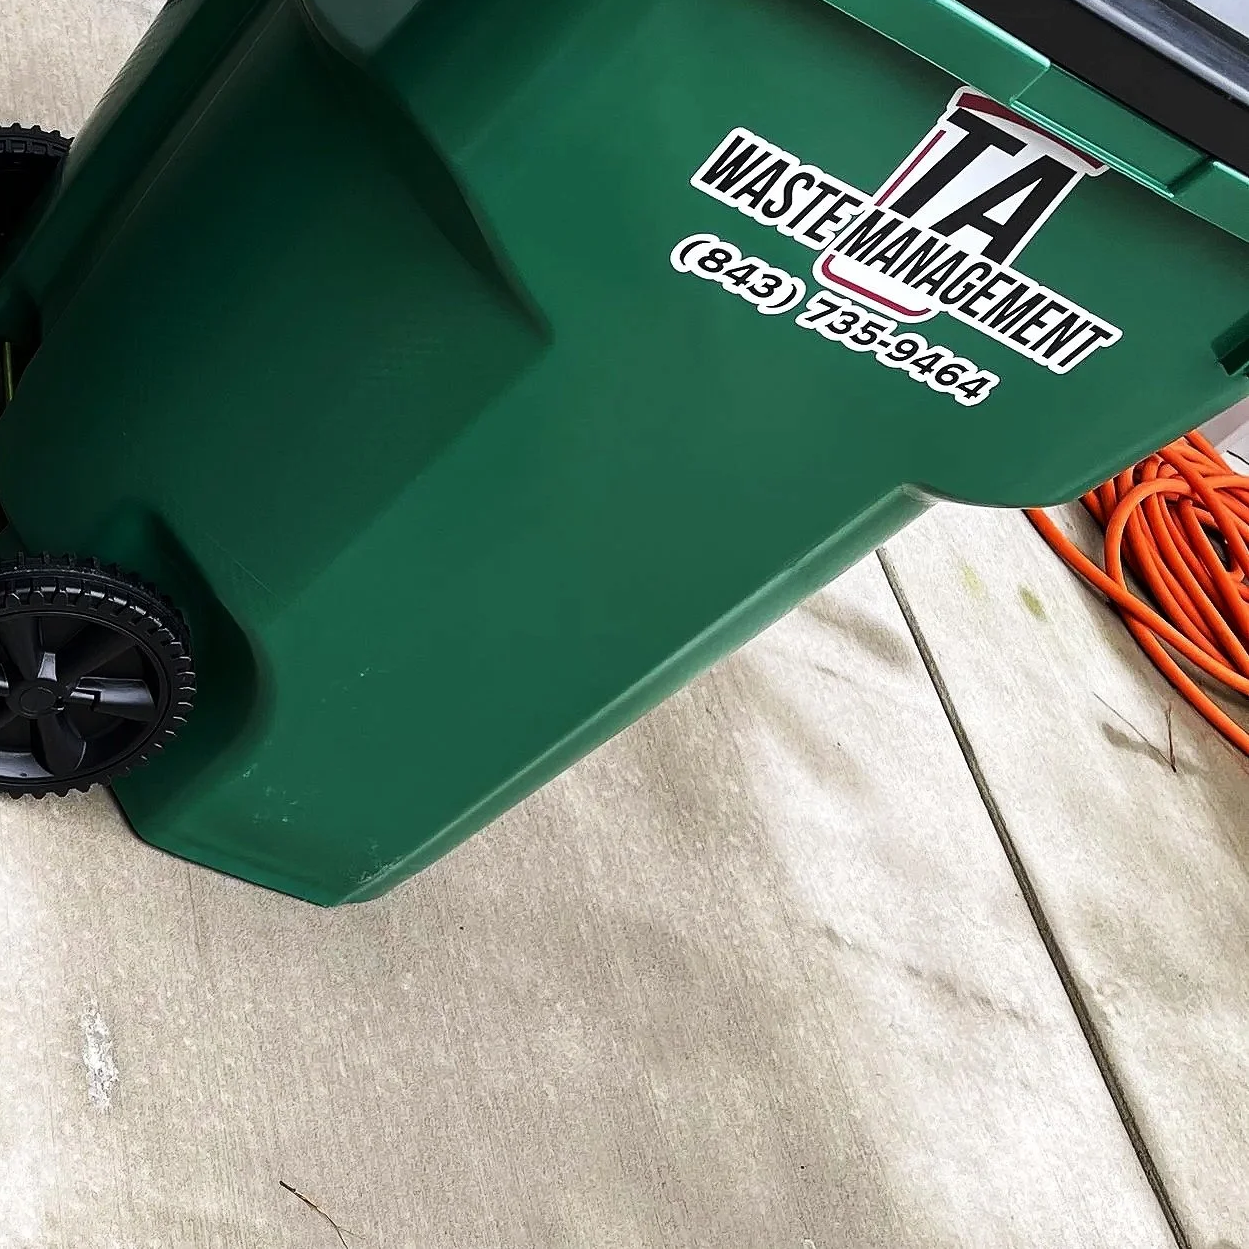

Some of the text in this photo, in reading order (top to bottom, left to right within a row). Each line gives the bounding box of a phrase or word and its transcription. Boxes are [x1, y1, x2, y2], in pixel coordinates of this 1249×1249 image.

[701, 135, 1113, 369] WASTE MANAGEMENT
[888, 107, 1080, 265] TA
[679, 240, 988, 401] (843) 735-9464
